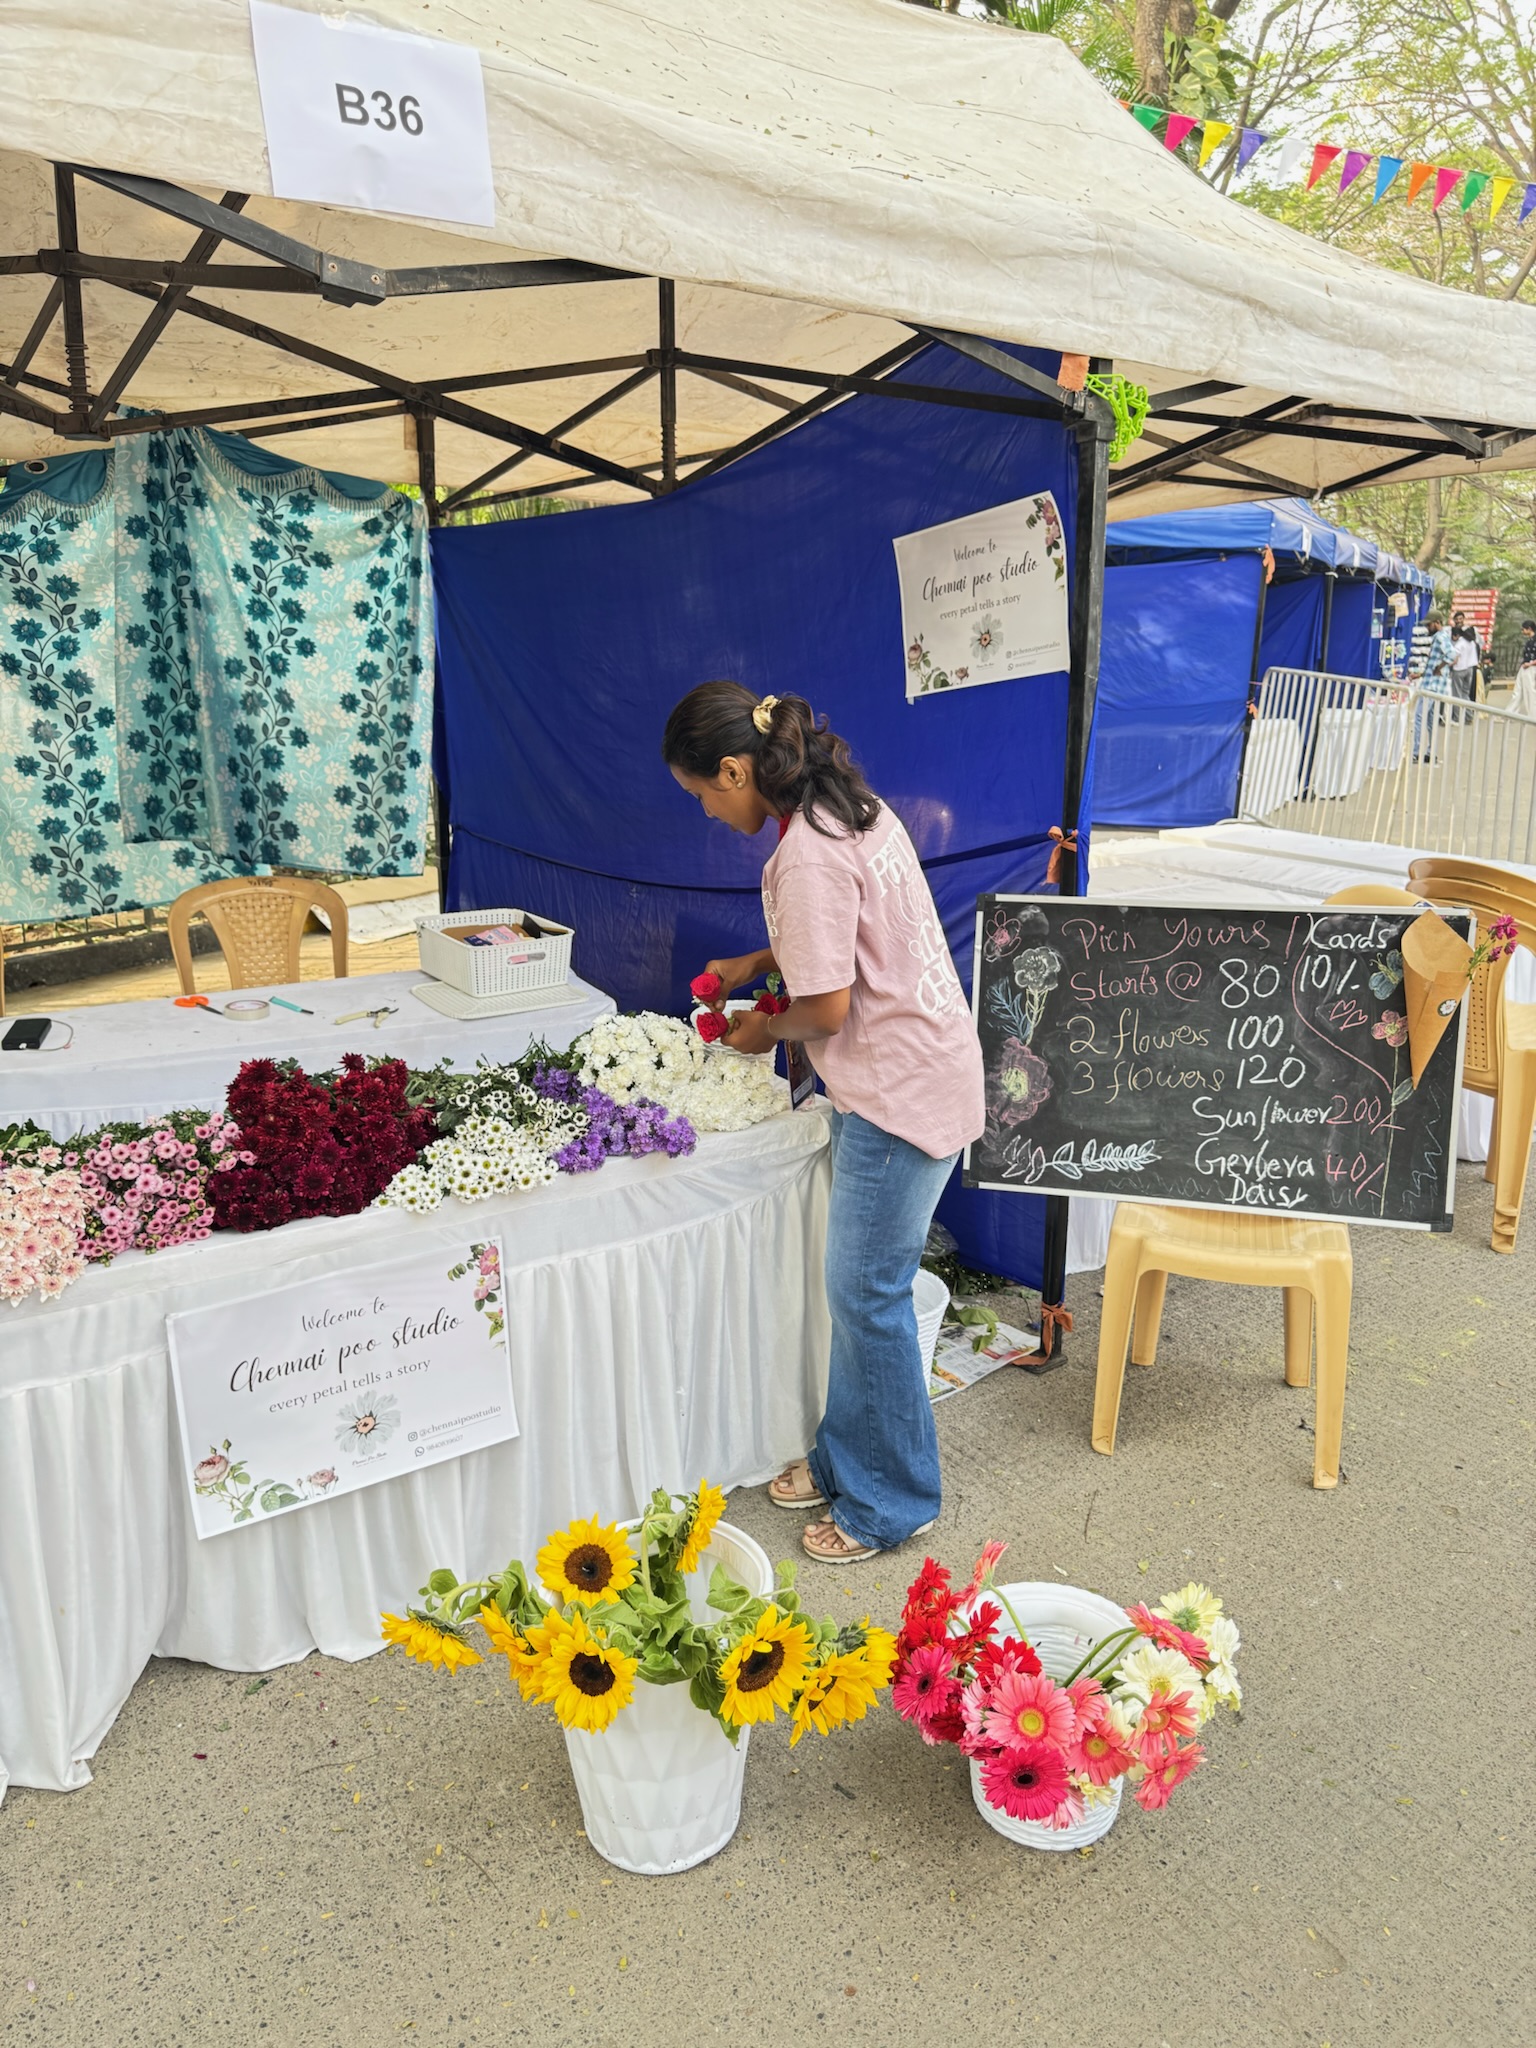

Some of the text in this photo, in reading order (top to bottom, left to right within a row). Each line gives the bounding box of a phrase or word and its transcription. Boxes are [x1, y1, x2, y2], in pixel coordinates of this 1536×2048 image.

[335, 83, 424, 136] B36
[953, 538, 997, 562] Welcome to
[922, 550, 1040, 603] Chennai poo studio
[939, 594, 1021, 621] every petal tells a story
[1219, 958, 1280, 1008] 80
[1066, 1016, 1108, 1054] 2
[1112, 1008, 1211, 1059] flowers
[1071, 1054, 1306, 1104] 3 flowers 120
[1192, 1096, 1332, 1141] Sunflower
[1195, 1138, 1316, 1182] Gerbera
[1225, 1173, 1309, 1209] Daisy
[302, 1296, 389, 1333] Welcome to
[229, 1307, 464, 1393] Chennai poo studio
[268, 1358, 431, 1413] every petal tells a story
[419, 1405, 502, 1437] @chennaipoostudio
